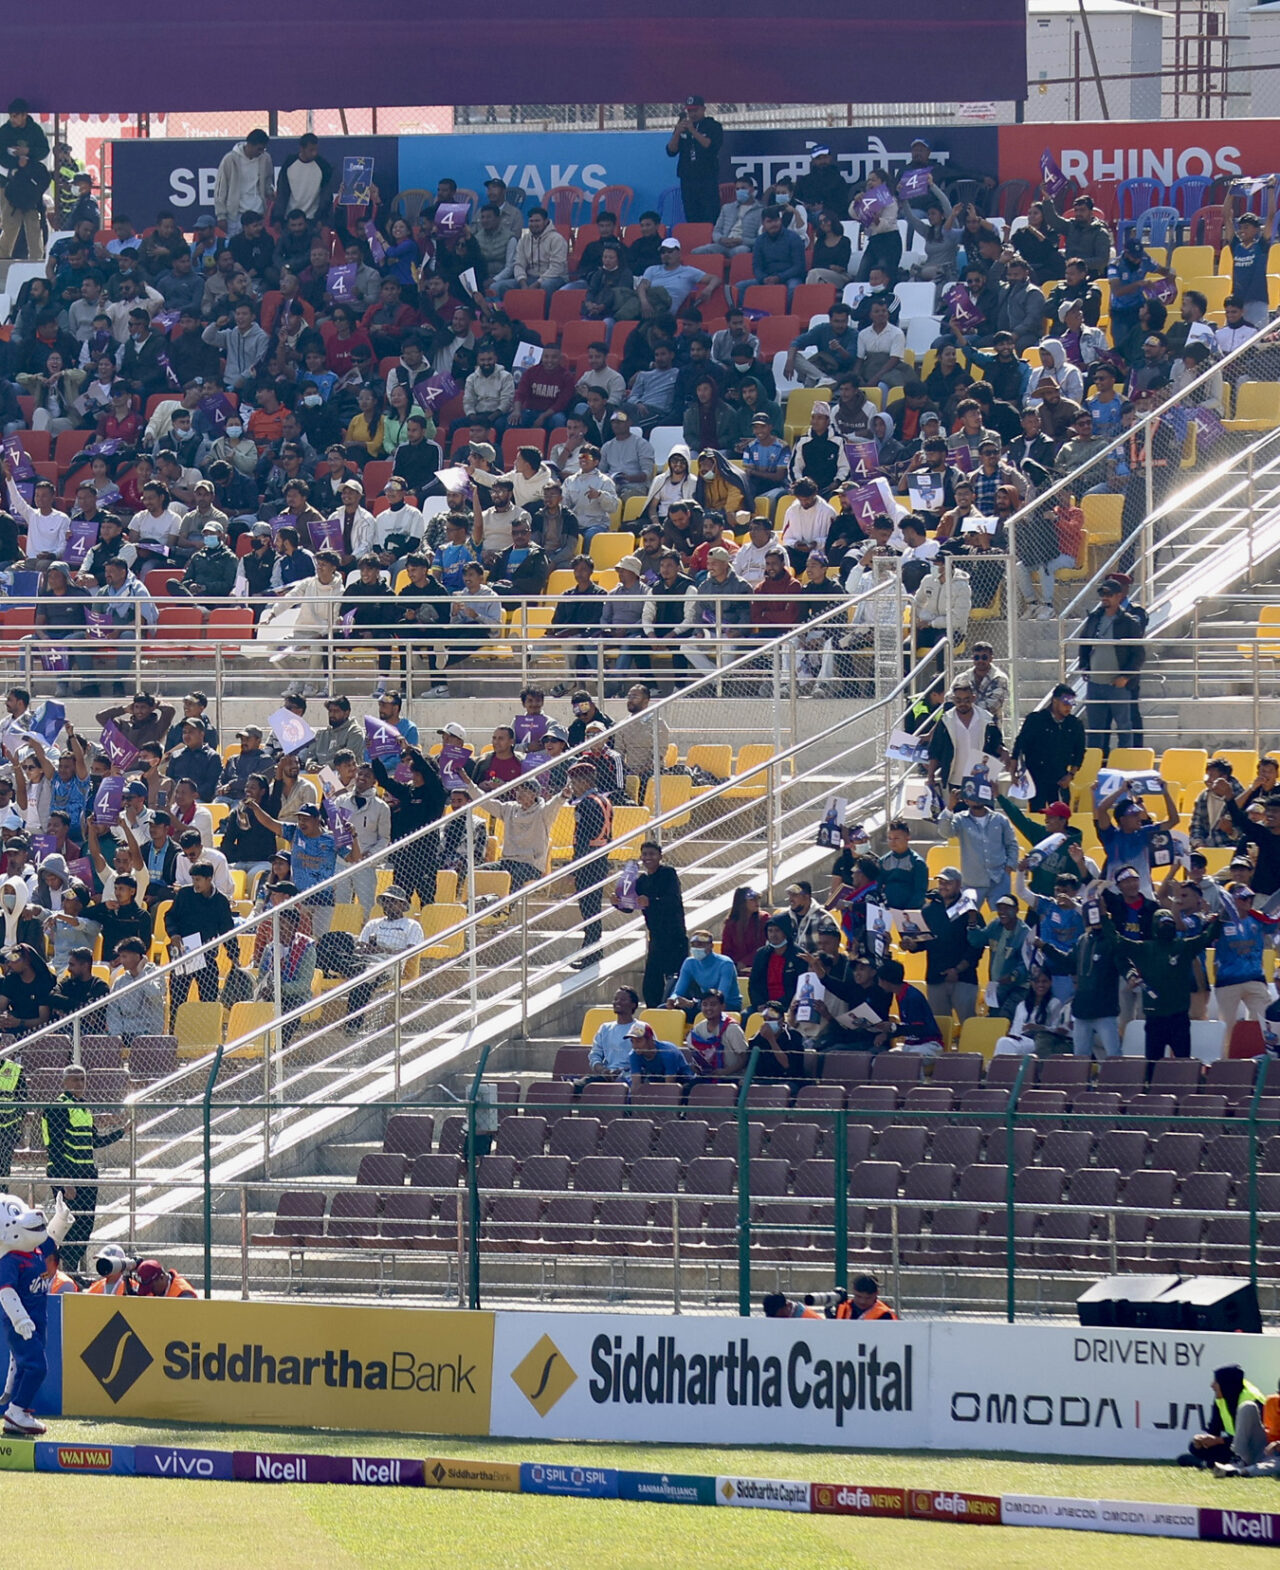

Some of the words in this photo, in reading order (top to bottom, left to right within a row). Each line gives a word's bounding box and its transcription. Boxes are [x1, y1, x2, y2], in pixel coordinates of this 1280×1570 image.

[1060, 146, 1242, 188] RHINOS
[484, 164, 608, 203] YAKS
[905, 174, 919, 188] 4
[441, 212, 455, 229] 4
[855, 459, 869, 479] 4
[862, 500, 876, 520] 4
[72, 536, 86, 556] 4
[373, 727, 388, 743] 4
[109, 740, 124, 759] 4
[443, 760, 454, 779] 4
[98, 792, 111, 814] 4
[1074, 1338, 1167, 1366] DRIVEN
[1175, 1342, 1206, 1368] BY
[589, 1333, 782, 1408] Siddhartha
[787, 1340, 914, 1428] Capital
[951, 1391, 1123, 1429] OMODA
[61, 1451, 84, 1465] WAI
[86, 1452, 110, 1466] WAI
[155, 1450, 214, 1476] vivo
[255, 1455, 307, 1481] Ncell
[351, 1458, 400, 1483] Ncell
[546, 1469, 568, 1482] SPIL
[586, 1471, 608, 1485] SPIL
[1222, 1510, 1274, 1539] Ncell
